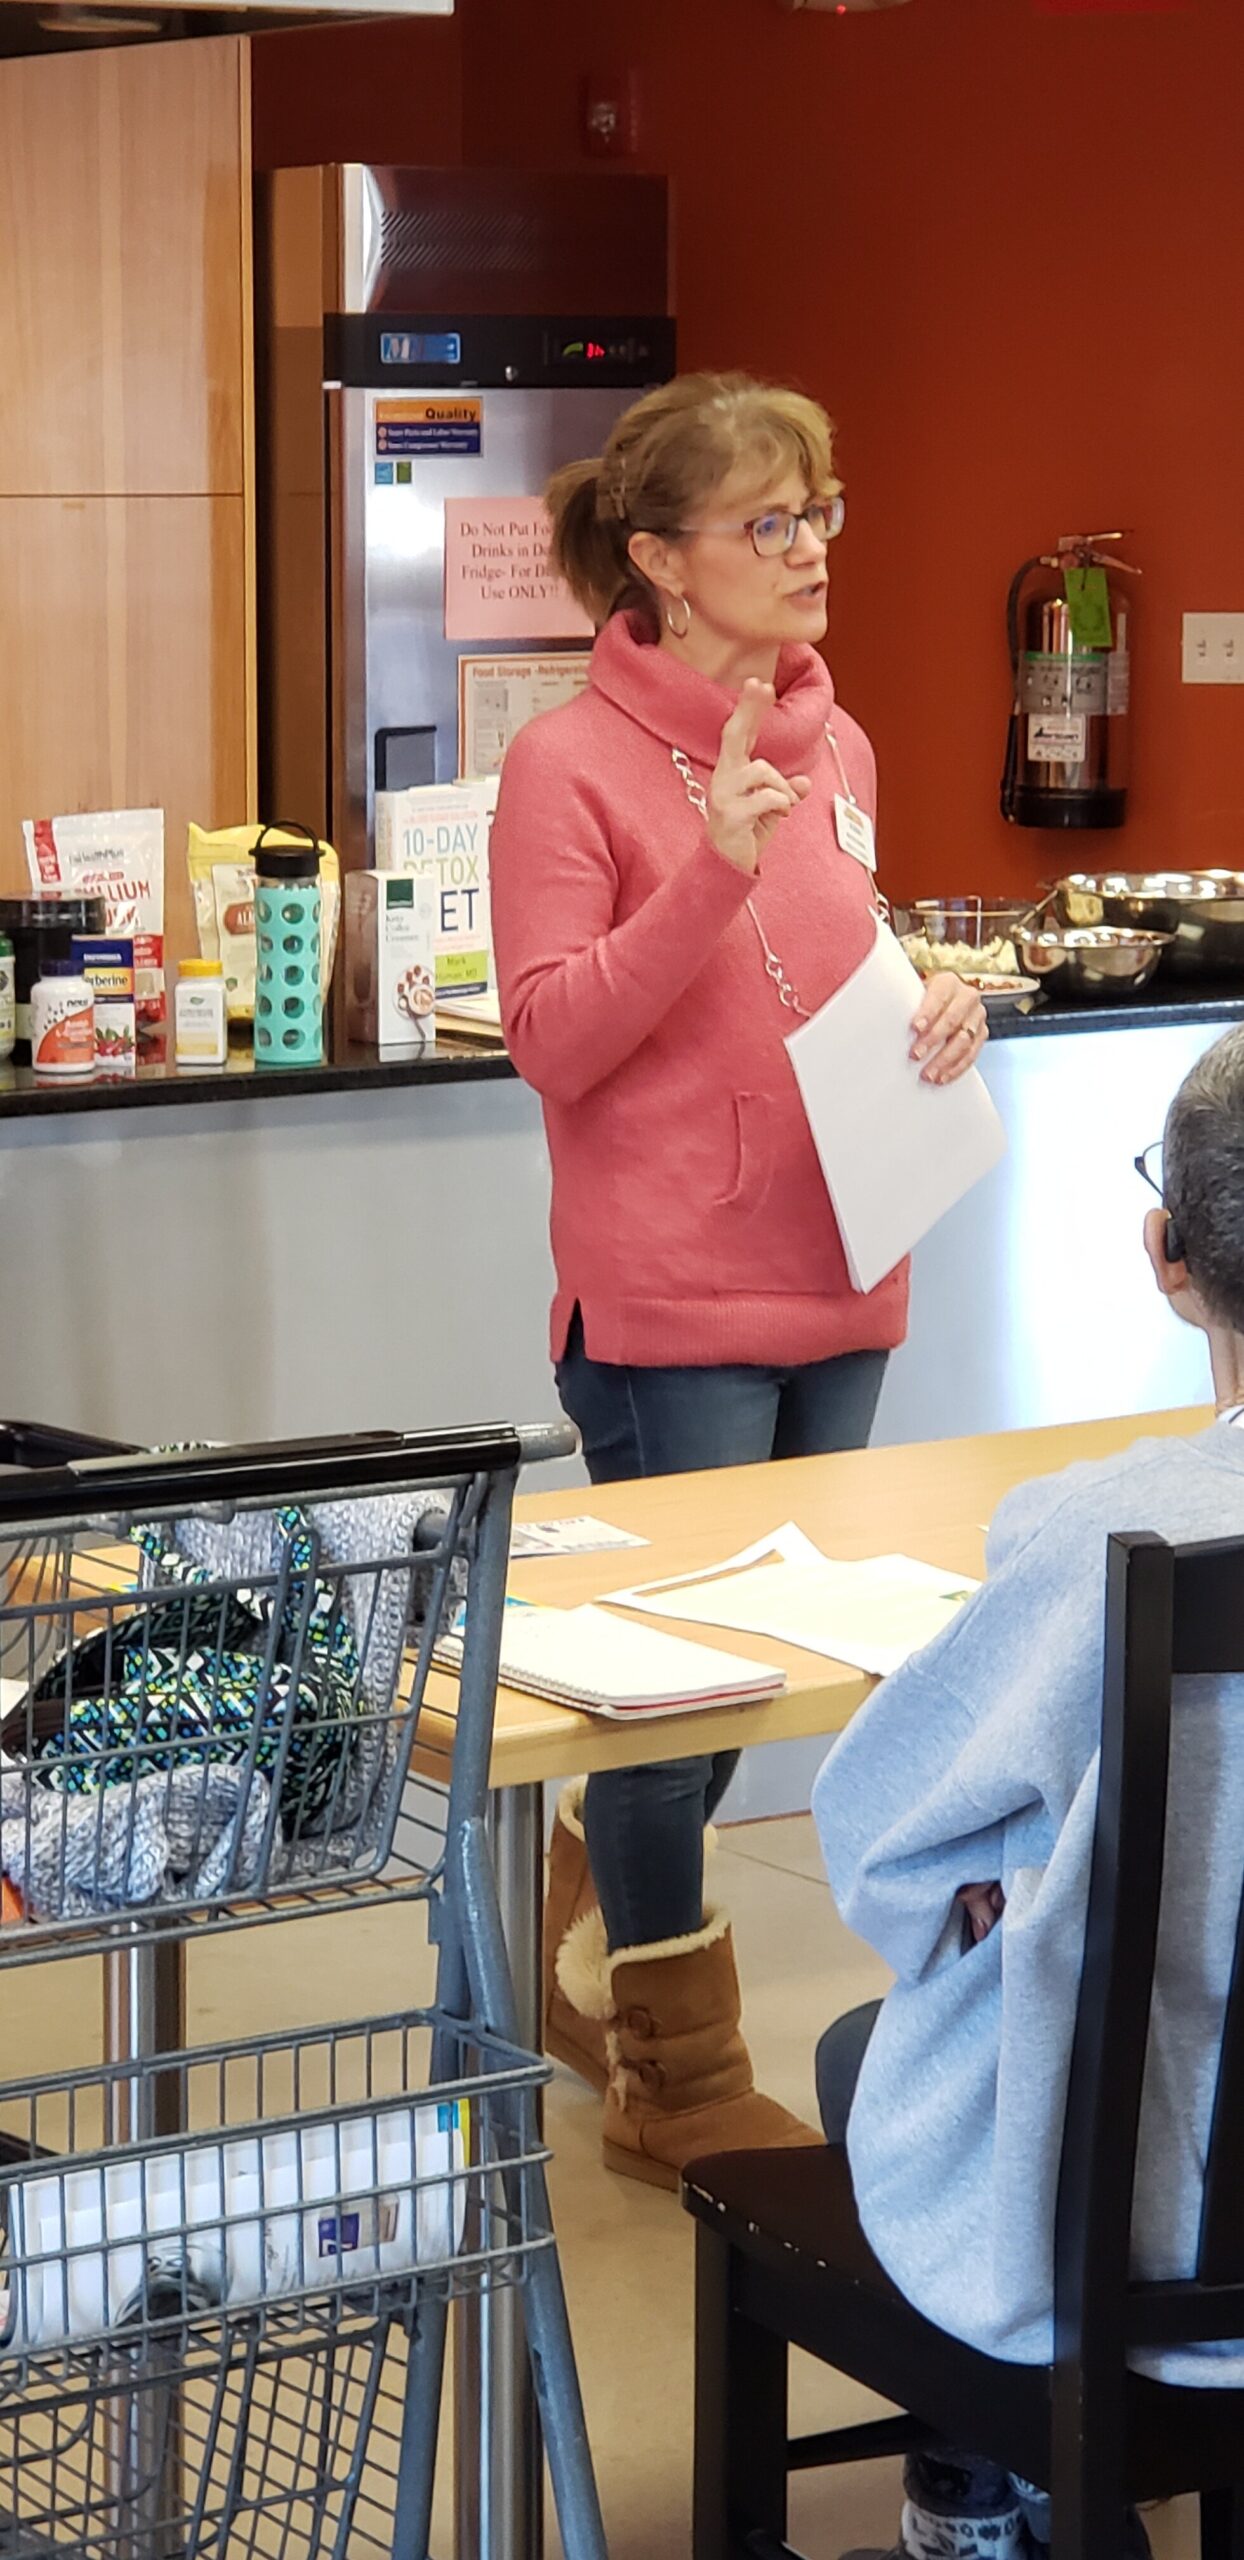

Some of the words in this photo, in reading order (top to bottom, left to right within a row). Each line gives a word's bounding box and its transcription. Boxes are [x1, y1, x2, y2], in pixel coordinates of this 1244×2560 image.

[426, 407, 477, 422] Quality
[461, 522, 479, 536] Do
[483, 522, 505, 536] Not
[510, 521, 528, 536] Put
[472, 543, 513, 558] Drinks
[517, 544, 529, 557] in
[462, 564, 506, 581] Fridge-
[511, 563, 531, 578] For
[481, 585, 505, 599] Use
[473, 666, 495, 679] Food
[497, 666, 531, 680] Storage
[403, 823, 478, 857] 10-DAY
[440, 887, 480, 934] ET
[84, 974, 128, 986] erberine
